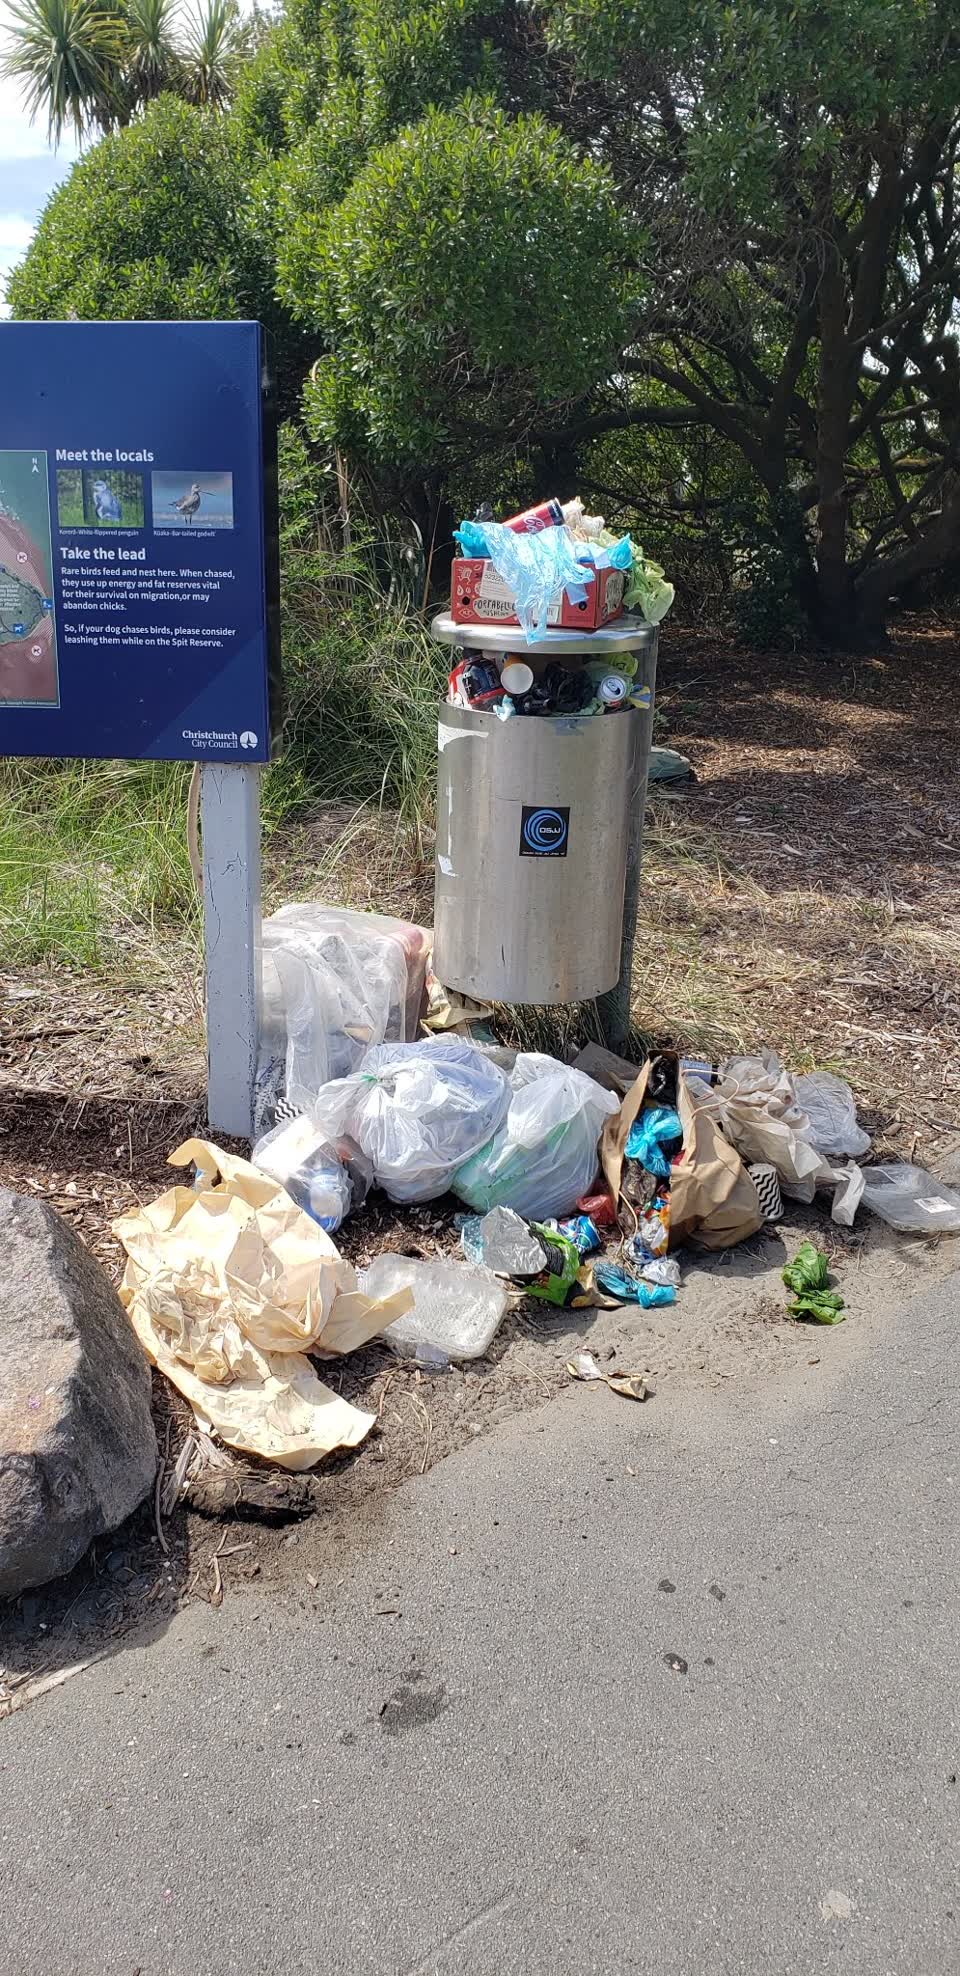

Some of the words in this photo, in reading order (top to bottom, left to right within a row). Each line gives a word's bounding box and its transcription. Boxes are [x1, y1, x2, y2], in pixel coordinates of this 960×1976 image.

[55, 449, 88, 461] Meet
[90, 449, 113, 461] the
[115, 449, 154, 462] locals
[60, 547, 91, 559] Take
[93, 547, 115, 560] the
[118, 547, 146, 560] lead
[61, 567, 80, 575] Rare
[81, 567, 102, 576] birds
[102, 567, 121, 576] feed
[121, 568, 138, 576] and
[139, 569, 156, 577] nest
[158, 568, 178, 577] here.
[179, 569, 203, 577] When
[204, 569, 235, 579] chased,
[61, 578, 80, 588] they
[96, 581, 107, 589] up
[108, 581, 136, 590] energy
[137, 579, 153, 588] and
[154, 580, 166, 588] fat
[202, 581, 220, 589] vital
[62, 590, 74, 598] for
[75, 590, 95, 598] their
[95, 590, 128, 599] survival
[192, 593, 210, 602] may
[63, 601, 98, 609] abandon
[99, 601, 128, 611] chicks.
[64, 624, 77, 633] So,
[78, 624, 85, 632] if
[85, 626, 104, 634] your
[104, 625, 121, 635] dog
[121, 625, 149, 634] chases
[149, 626, 174, 635] birds,
[174, 626, 201, 636] please
[201, 627, 236, 636] consider
[64, 635, 99, 645] leashing
[99, 636, 121, 644] them
[121, 637, 144, 645] while
[156, 637, 171, 646] the
[171, 638, 189, 648] Spit
[189, 638, 224, 647] Reserve.
[182, 730, 238, 740] Christchurch
[191, 739, 207, 749] City
[208, 740, 238, 749] Council
